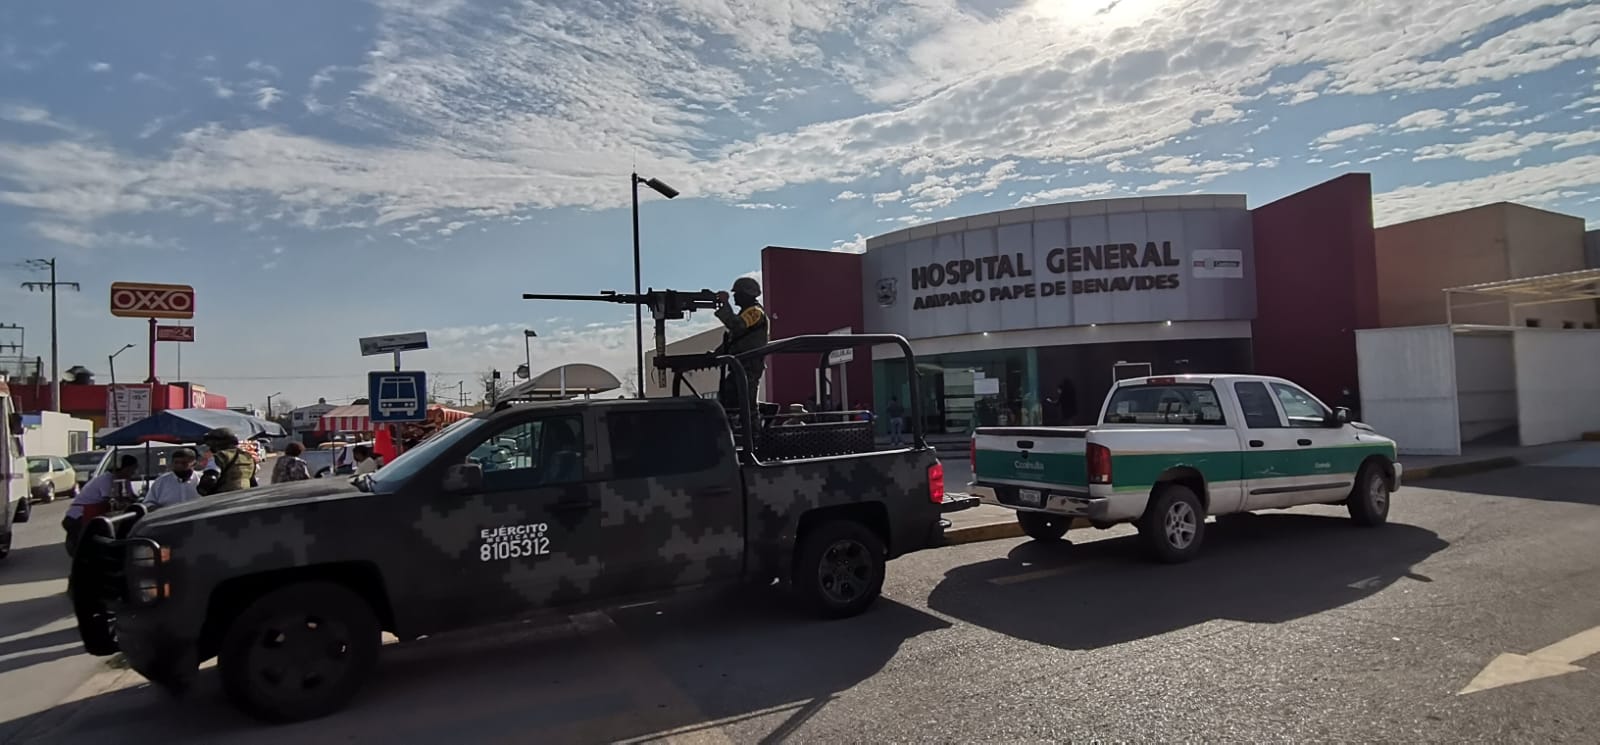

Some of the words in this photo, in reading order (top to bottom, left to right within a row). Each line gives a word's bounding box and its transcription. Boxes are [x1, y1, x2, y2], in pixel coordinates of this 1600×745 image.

[911, 252, 1032, 290] HOSPITAL
[1046, 241, 1180, 274] GENERAL
[112, 289, 191, 311] OXXO
[913, 288, 986, 310] AMPARO
[989, 283, 1036, 302] PAPE
[1040, 281, 1066, 297] DE
[1071, 273, 1180, 295] BENAVIDES
[480, 537, 550, 562] 8105312
